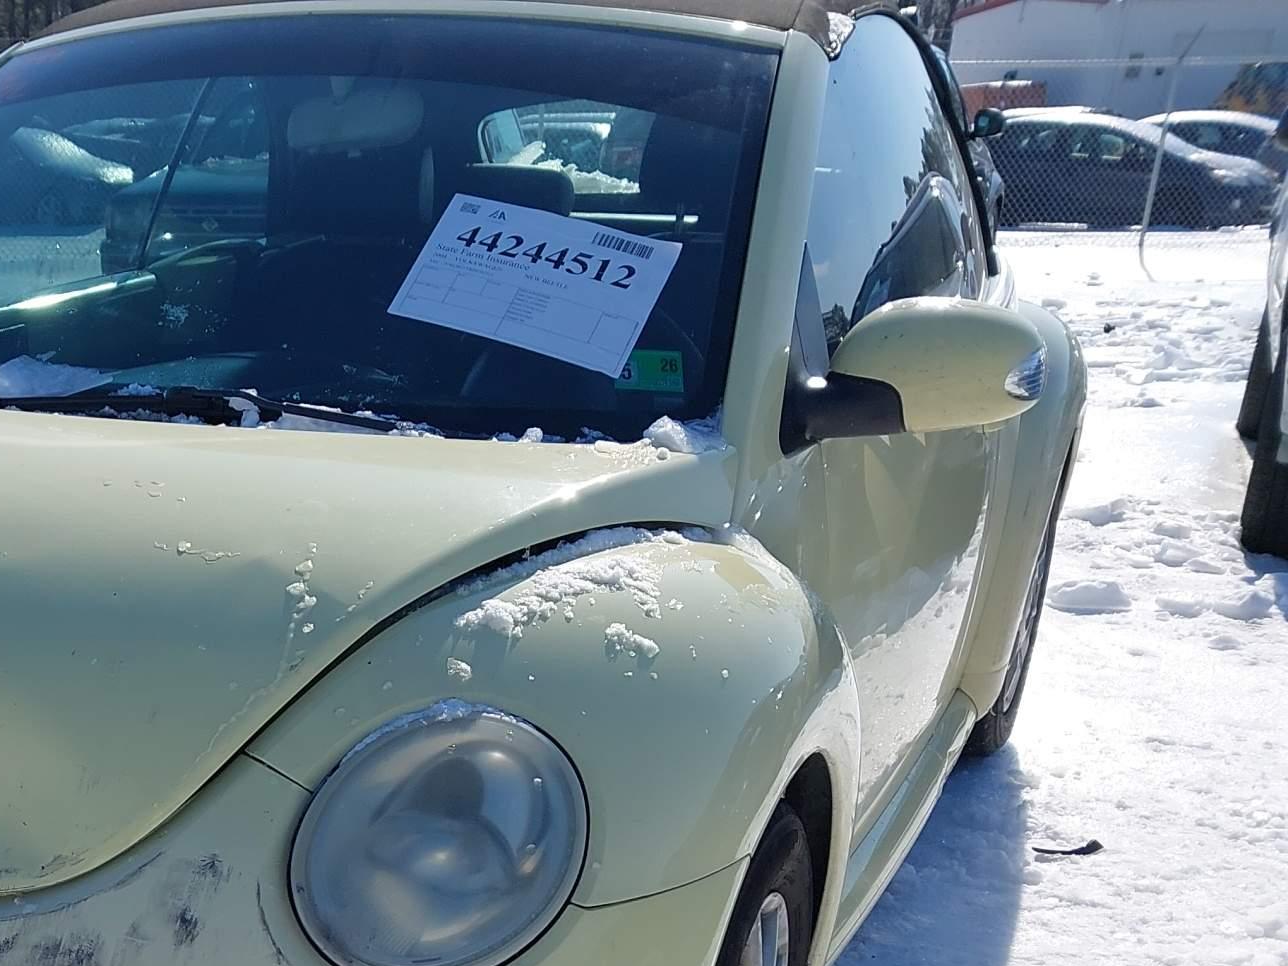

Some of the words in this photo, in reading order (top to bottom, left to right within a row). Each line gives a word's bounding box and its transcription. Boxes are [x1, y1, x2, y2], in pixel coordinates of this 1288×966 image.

[437, 243, 458, 253] State
[461, 247, 484, 260] Farm
[487, 254, 531, 271] Insurance
[456, 225, 637, 290] 44244512
[660, 358, 678, 373] 26
